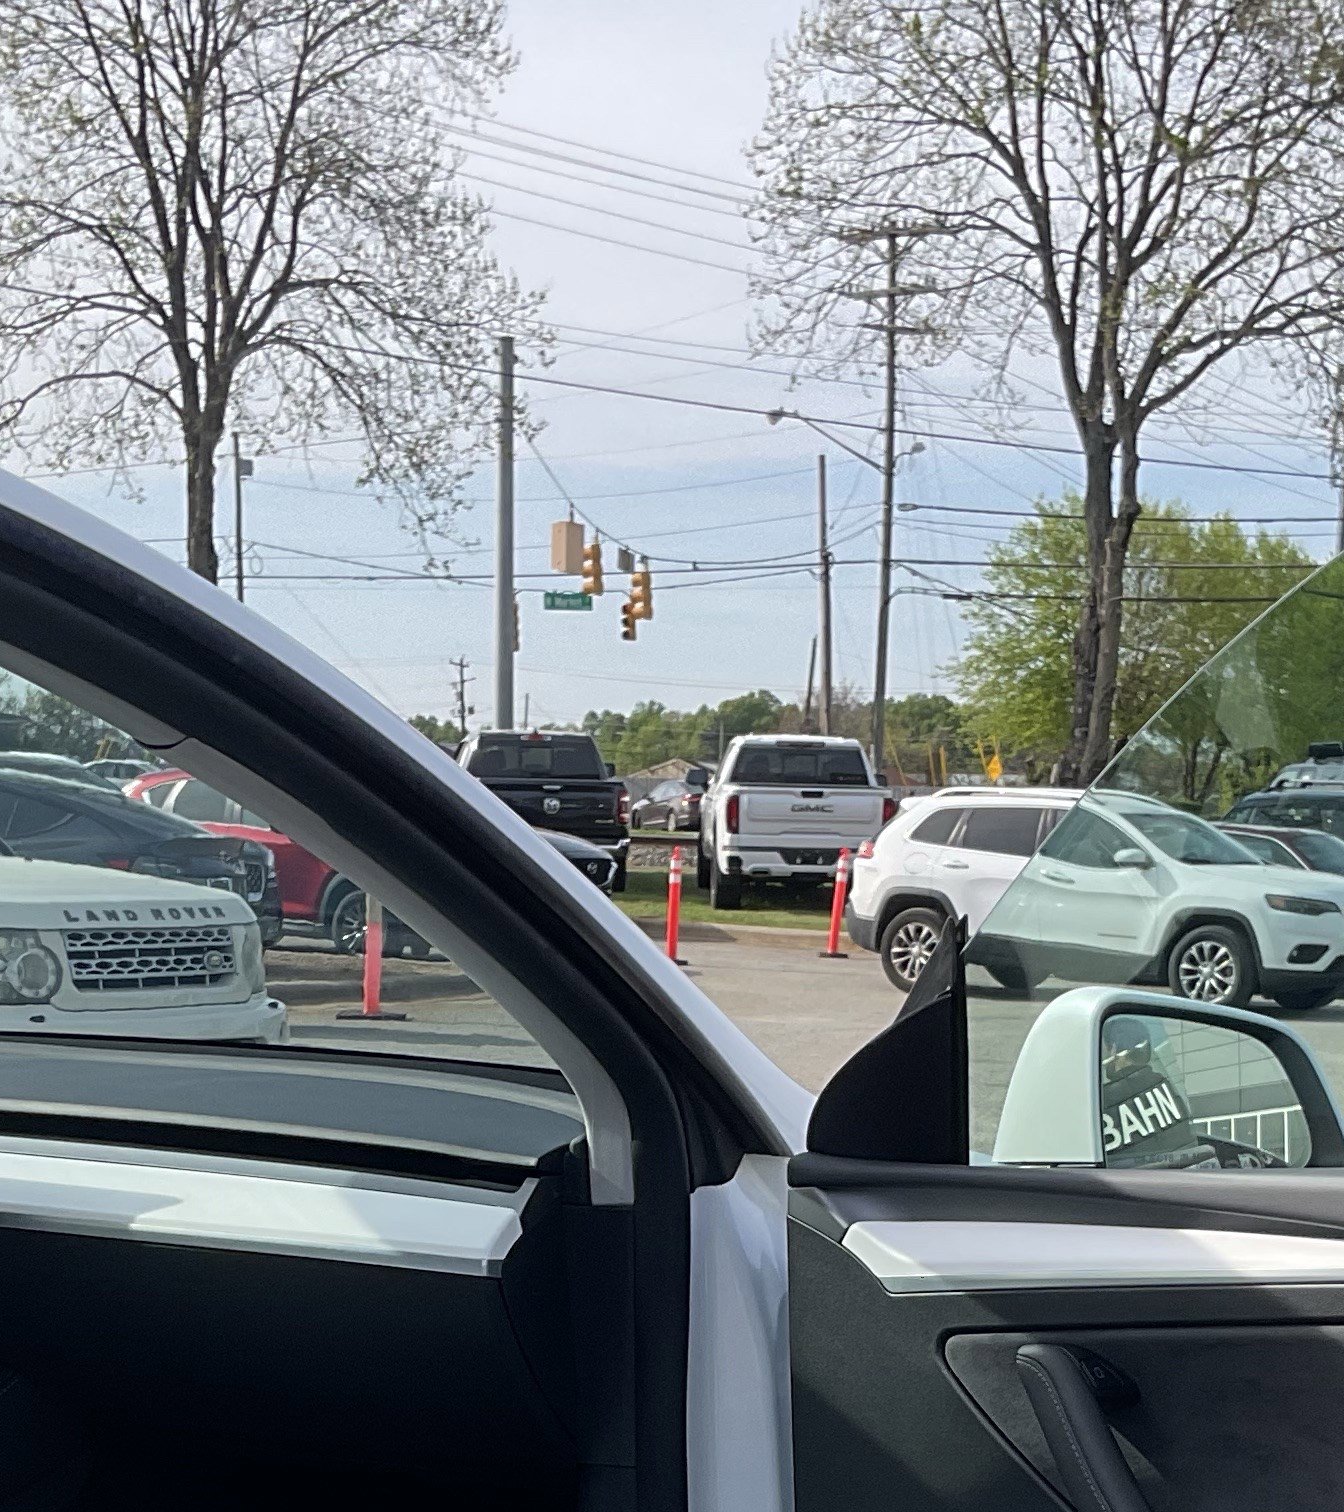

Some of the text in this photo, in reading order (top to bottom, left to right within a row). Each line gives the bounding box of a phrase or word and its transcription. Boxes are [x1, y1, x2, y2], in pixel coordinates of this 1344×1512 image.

[791, 804, 834, 813] GMC
[63, 906, 226, 922] LAND ROVER
[1102, 1083, 1181, 1152] BAHN
